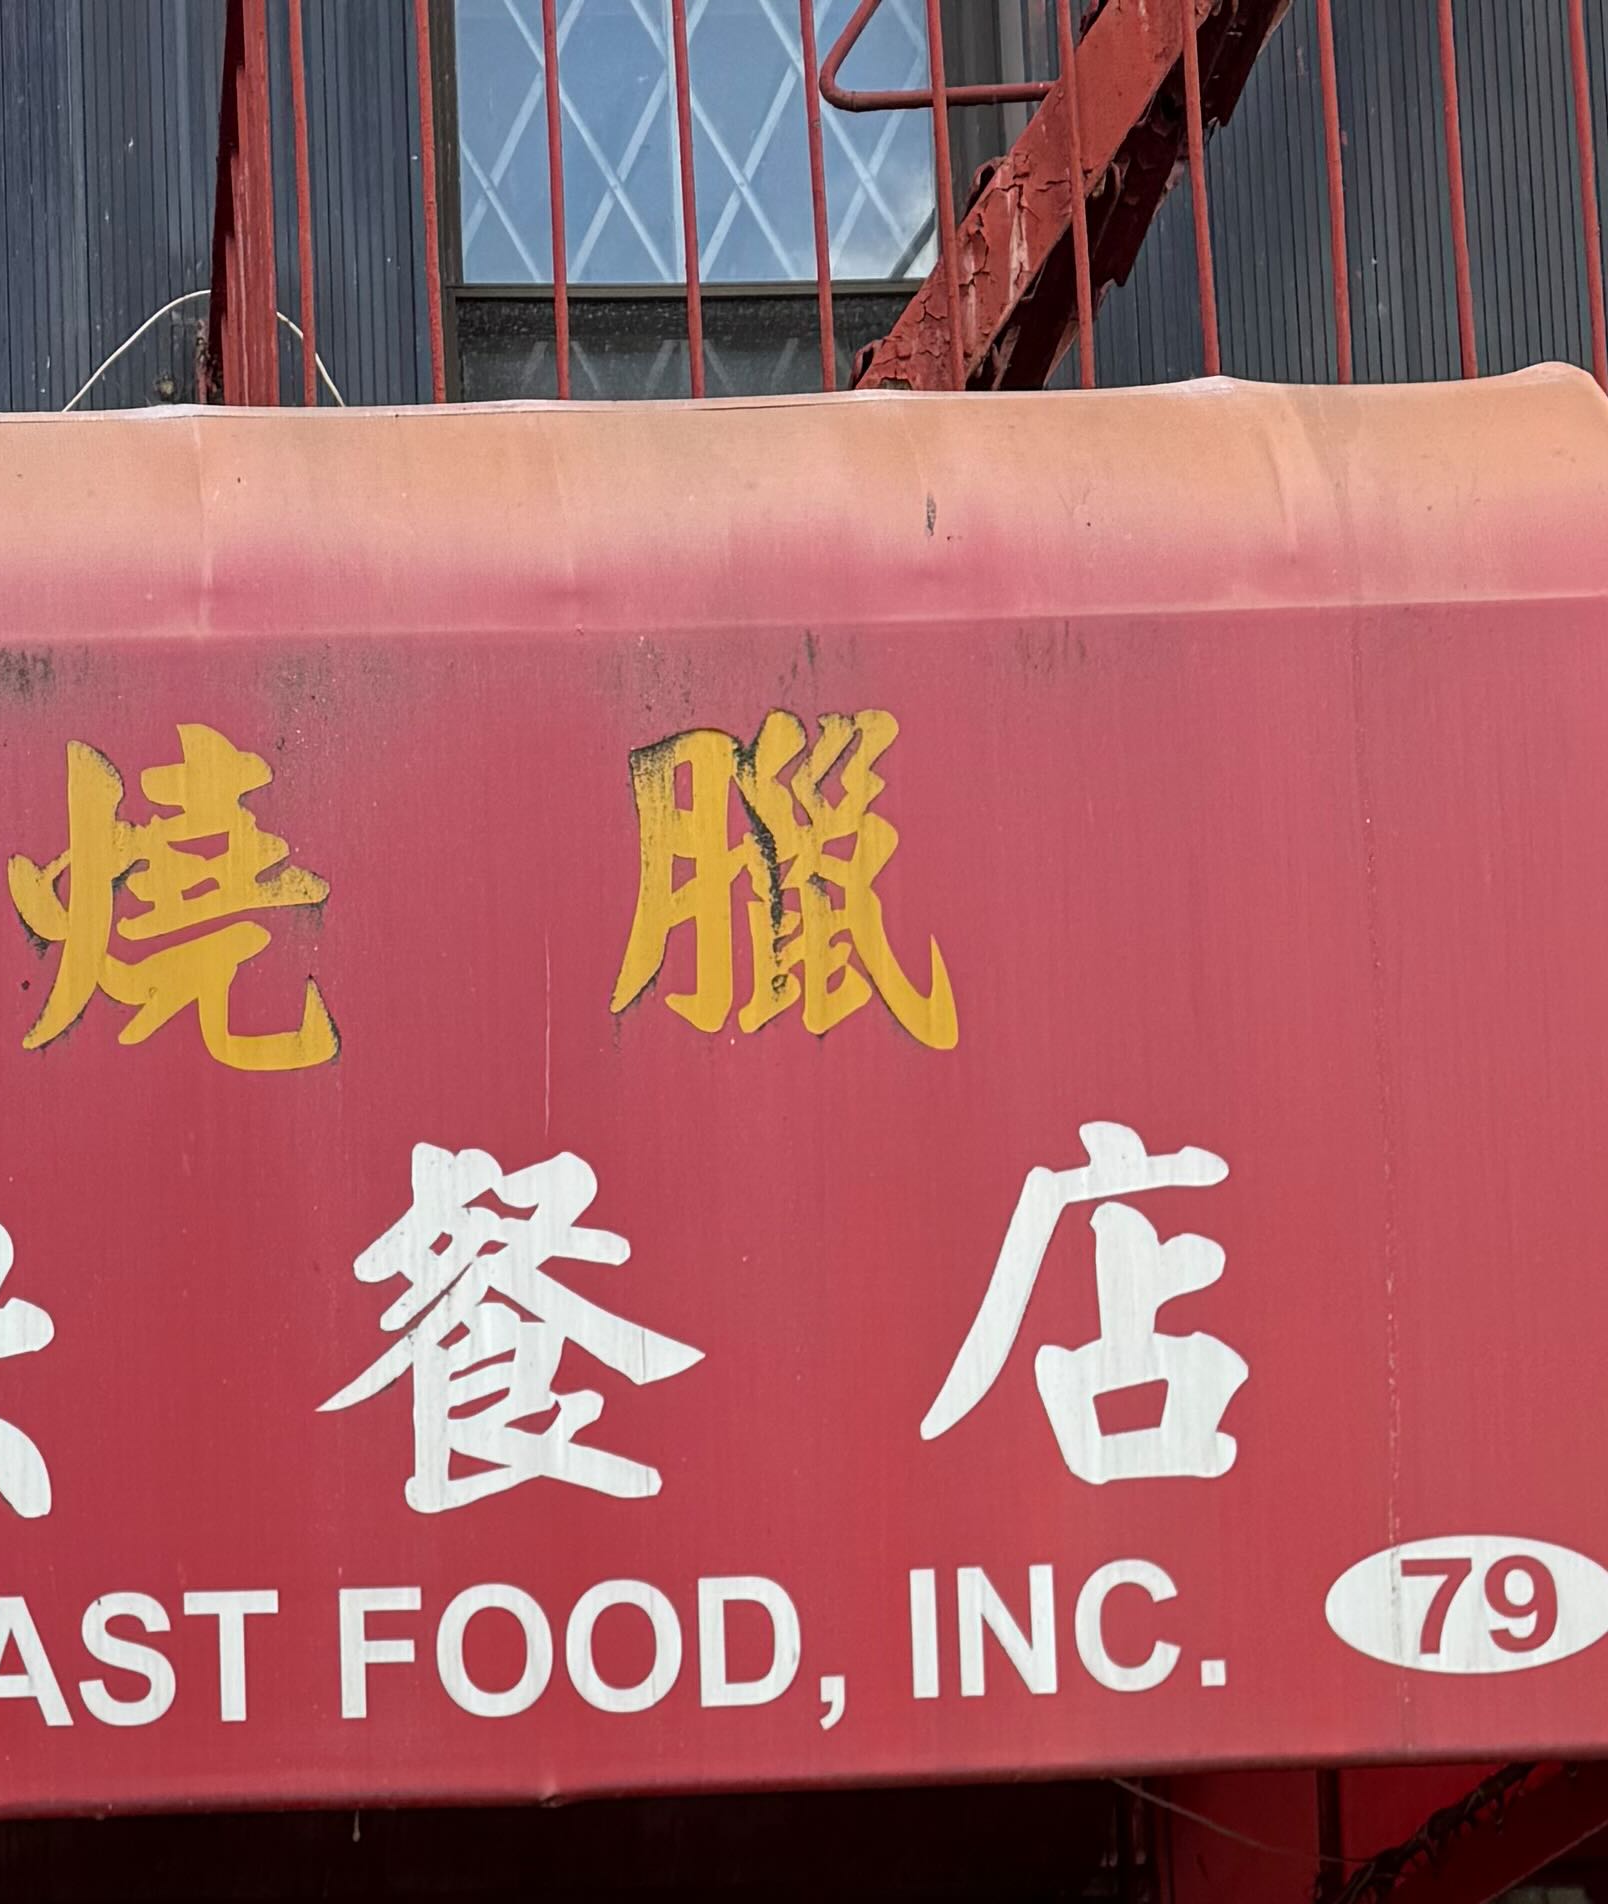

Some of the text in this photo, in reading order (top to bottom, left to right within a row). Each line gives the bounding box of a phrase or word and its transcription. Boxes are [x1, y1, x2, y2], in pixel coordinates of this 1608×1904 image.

[339, 1576, 846, 1730] FOOD,
[909, 1559, 1227, 1699] INC.
[1399, 1553, 1559, 1655] 79
